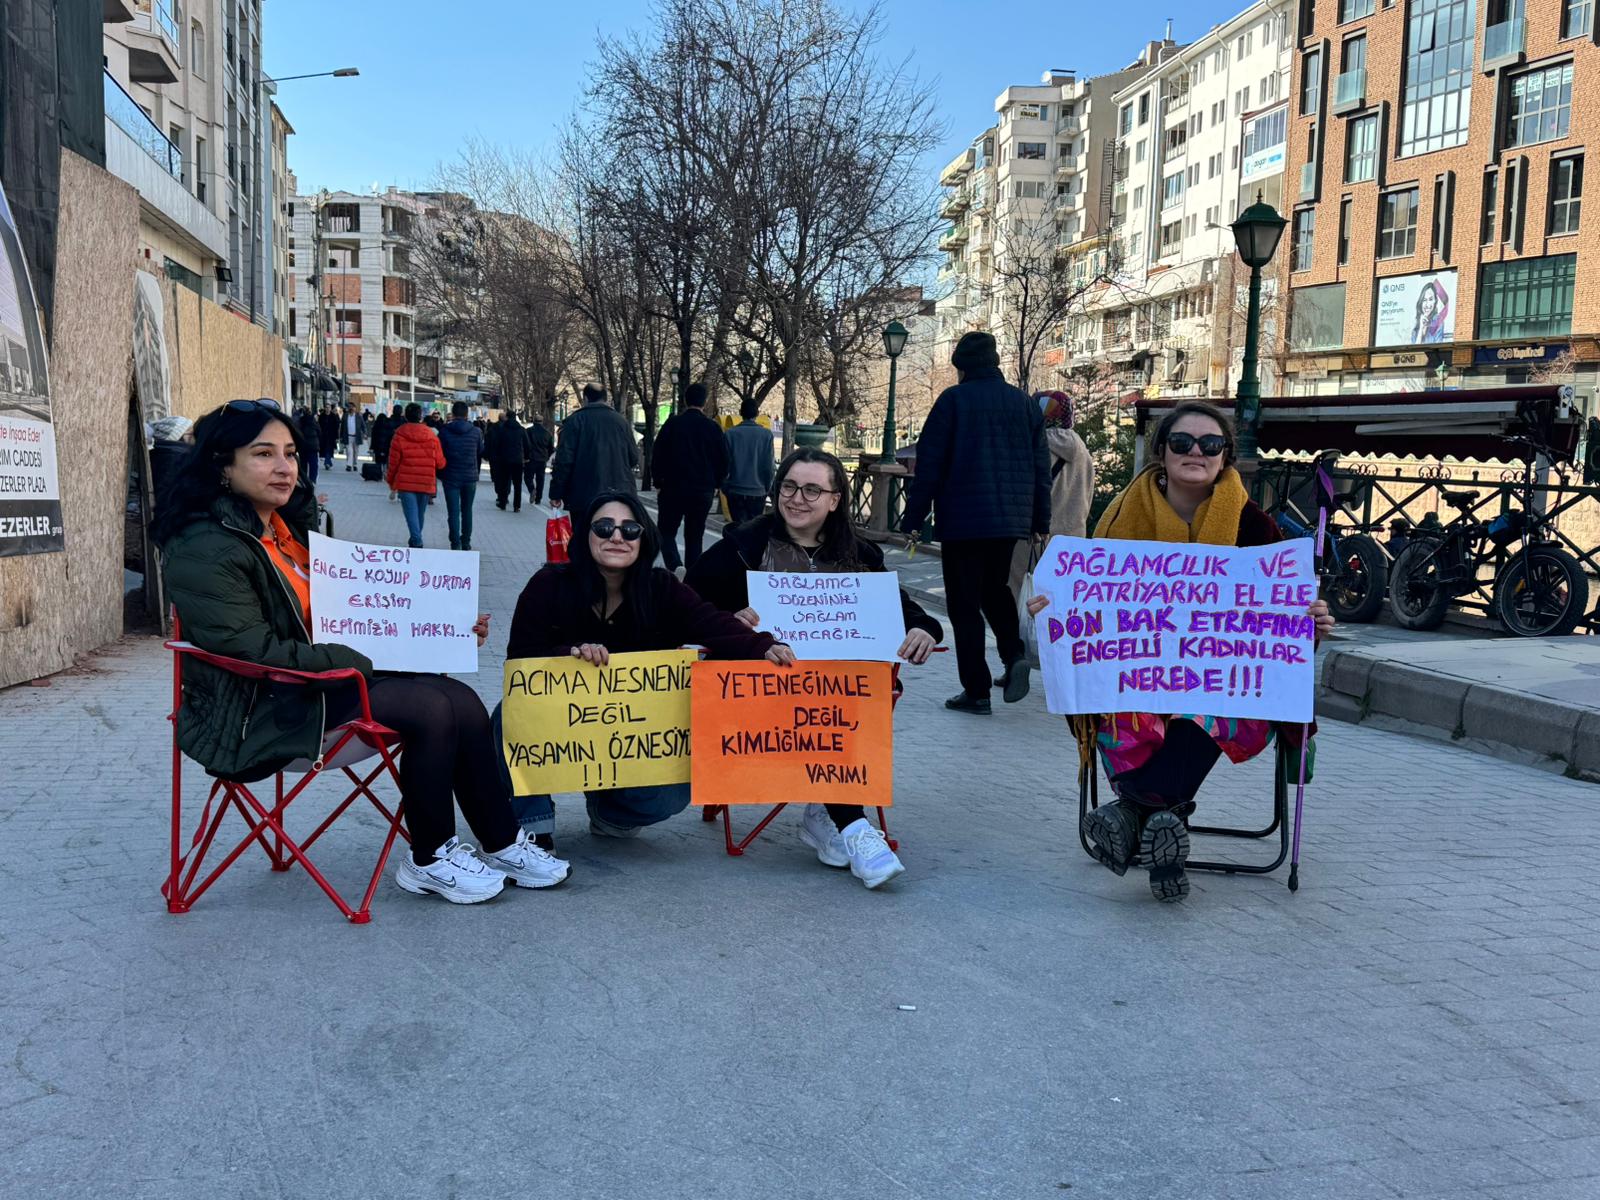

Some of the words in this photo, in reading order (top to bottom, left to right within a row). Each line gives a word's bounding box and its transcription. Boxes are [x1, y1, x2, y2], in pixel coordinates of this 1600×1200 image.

[1400, 354, 1416, 364] QNB
[13, 448, 42, 468] CADDESİ
[28, 476, 47, 493] PLAZA
[313, 558, 358, 581] ENGEL
[365, 568, 410, 585] KOYUP
[419, 571, 472, 591] DURMA
[1054, 547, 1230, 578] SAĞLAMCILIK
[1257, 547, 1298, 578] VE
[768, 574, 861, 590] SAĞLAMCI
[1073, 577, 1219, 605] PATRİYARKA
[1235, 583, 1264, 607] EL
[1270, 583, 1313, 607] ELE
[792, 610, 857, 623] SAĞLAM
[1048, 608, 1103, 644] DÖN
[1117, 605, 1178, 633] BAK
[1188, 610, 1316, 640] ETRAFINA
[1072, 632, 1161, 665] ENGELLİ
[1179, 636, 1308, 664] KADINLAR
[508, 670, 590, 697] ACIMA
[717, 670, 872, 699] YETENEĞİMLE
[568, 702, 646, 728] DEĞİL
[794, 704, 860, 731] DEĞİL,
[508, 740, 595, 768] YAŞAMIN
[721, 726, 844, 756] KİMLİĞİMLE
[805, 763, 868, 786] VARIM!
